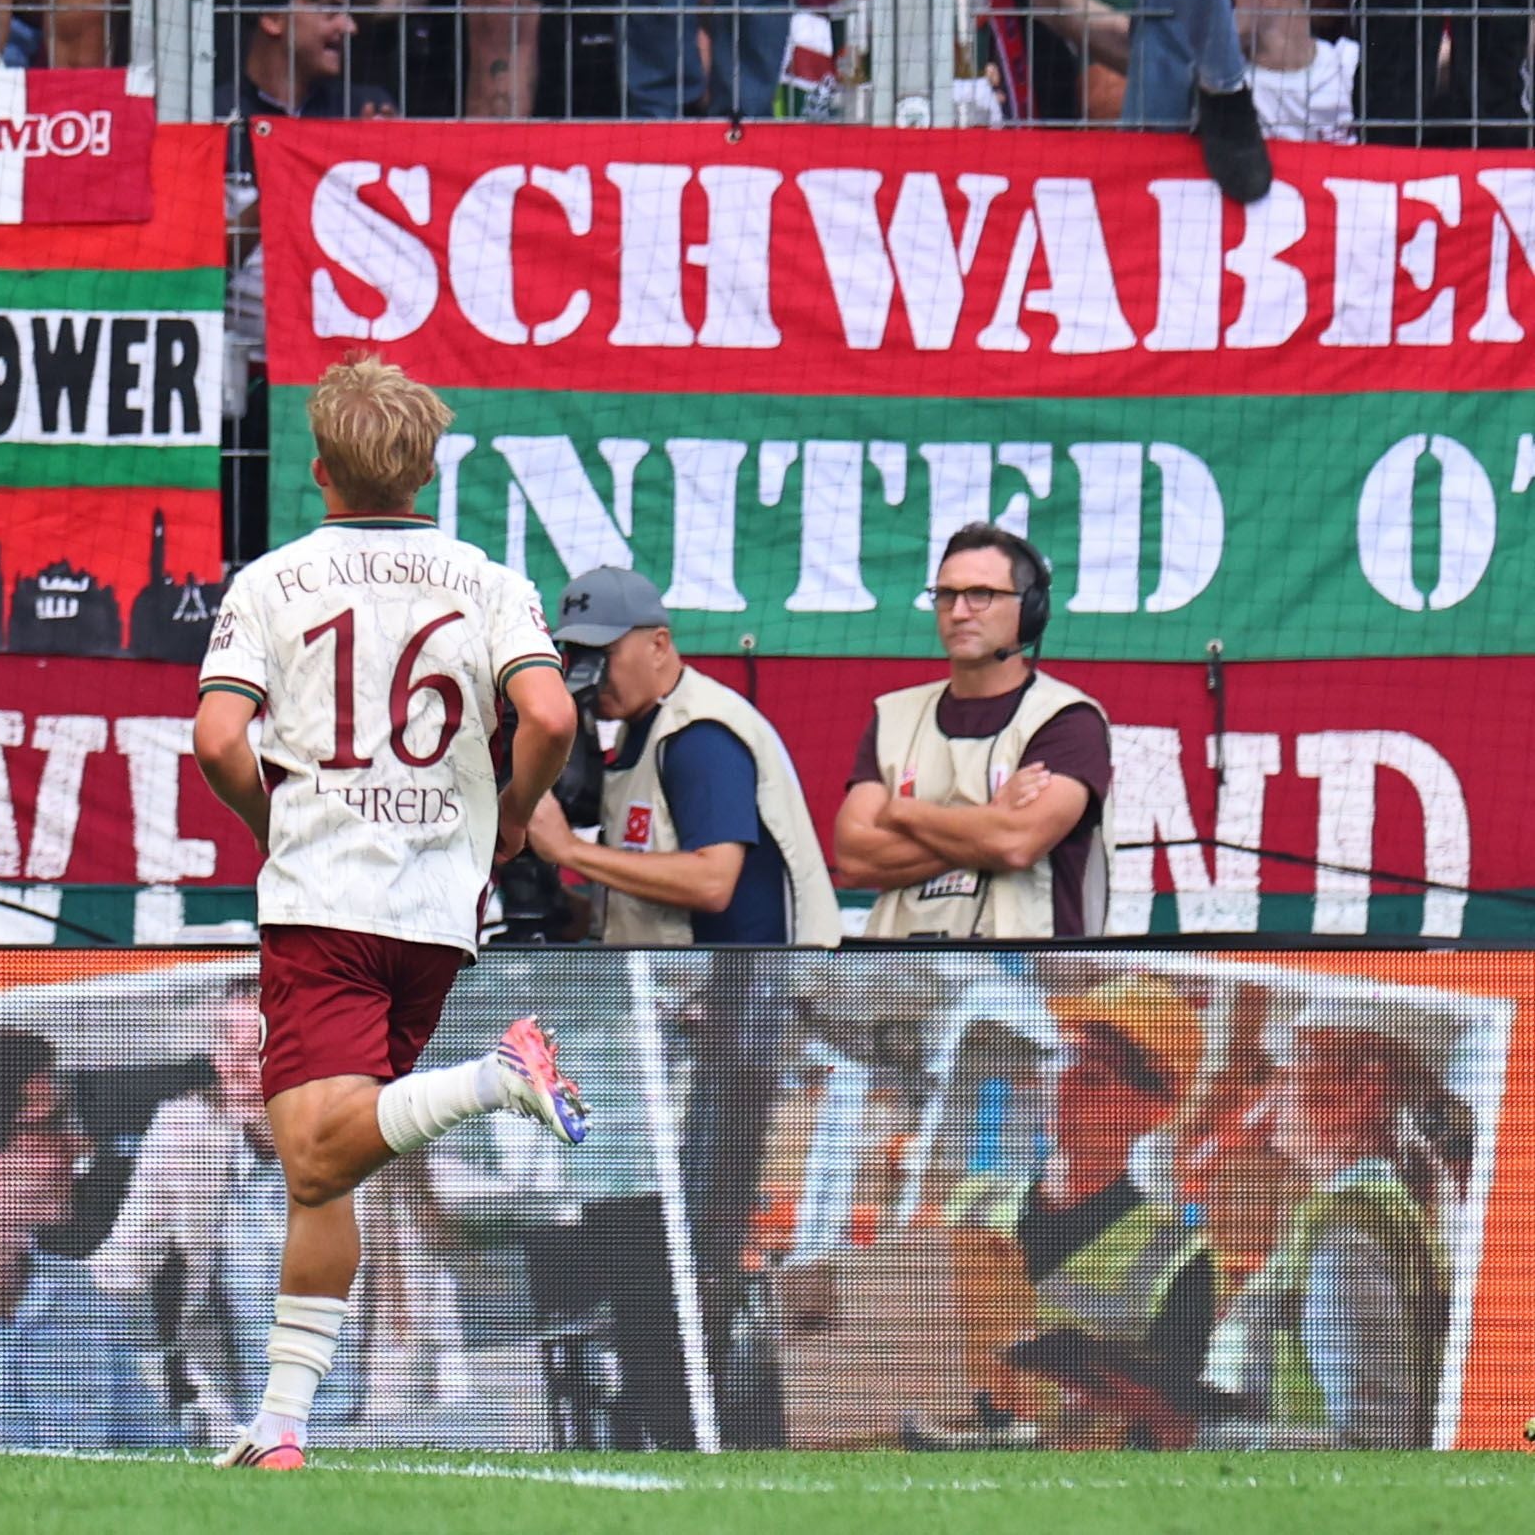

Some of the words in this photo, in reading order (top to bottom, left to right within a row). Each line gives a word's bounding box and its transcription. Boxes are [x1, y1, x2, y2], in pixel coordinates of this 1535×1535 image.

[274, 561, 321, 605] FC
[437, 432, 1225, 614] NITED
[302, 607, 466, 770] 16
